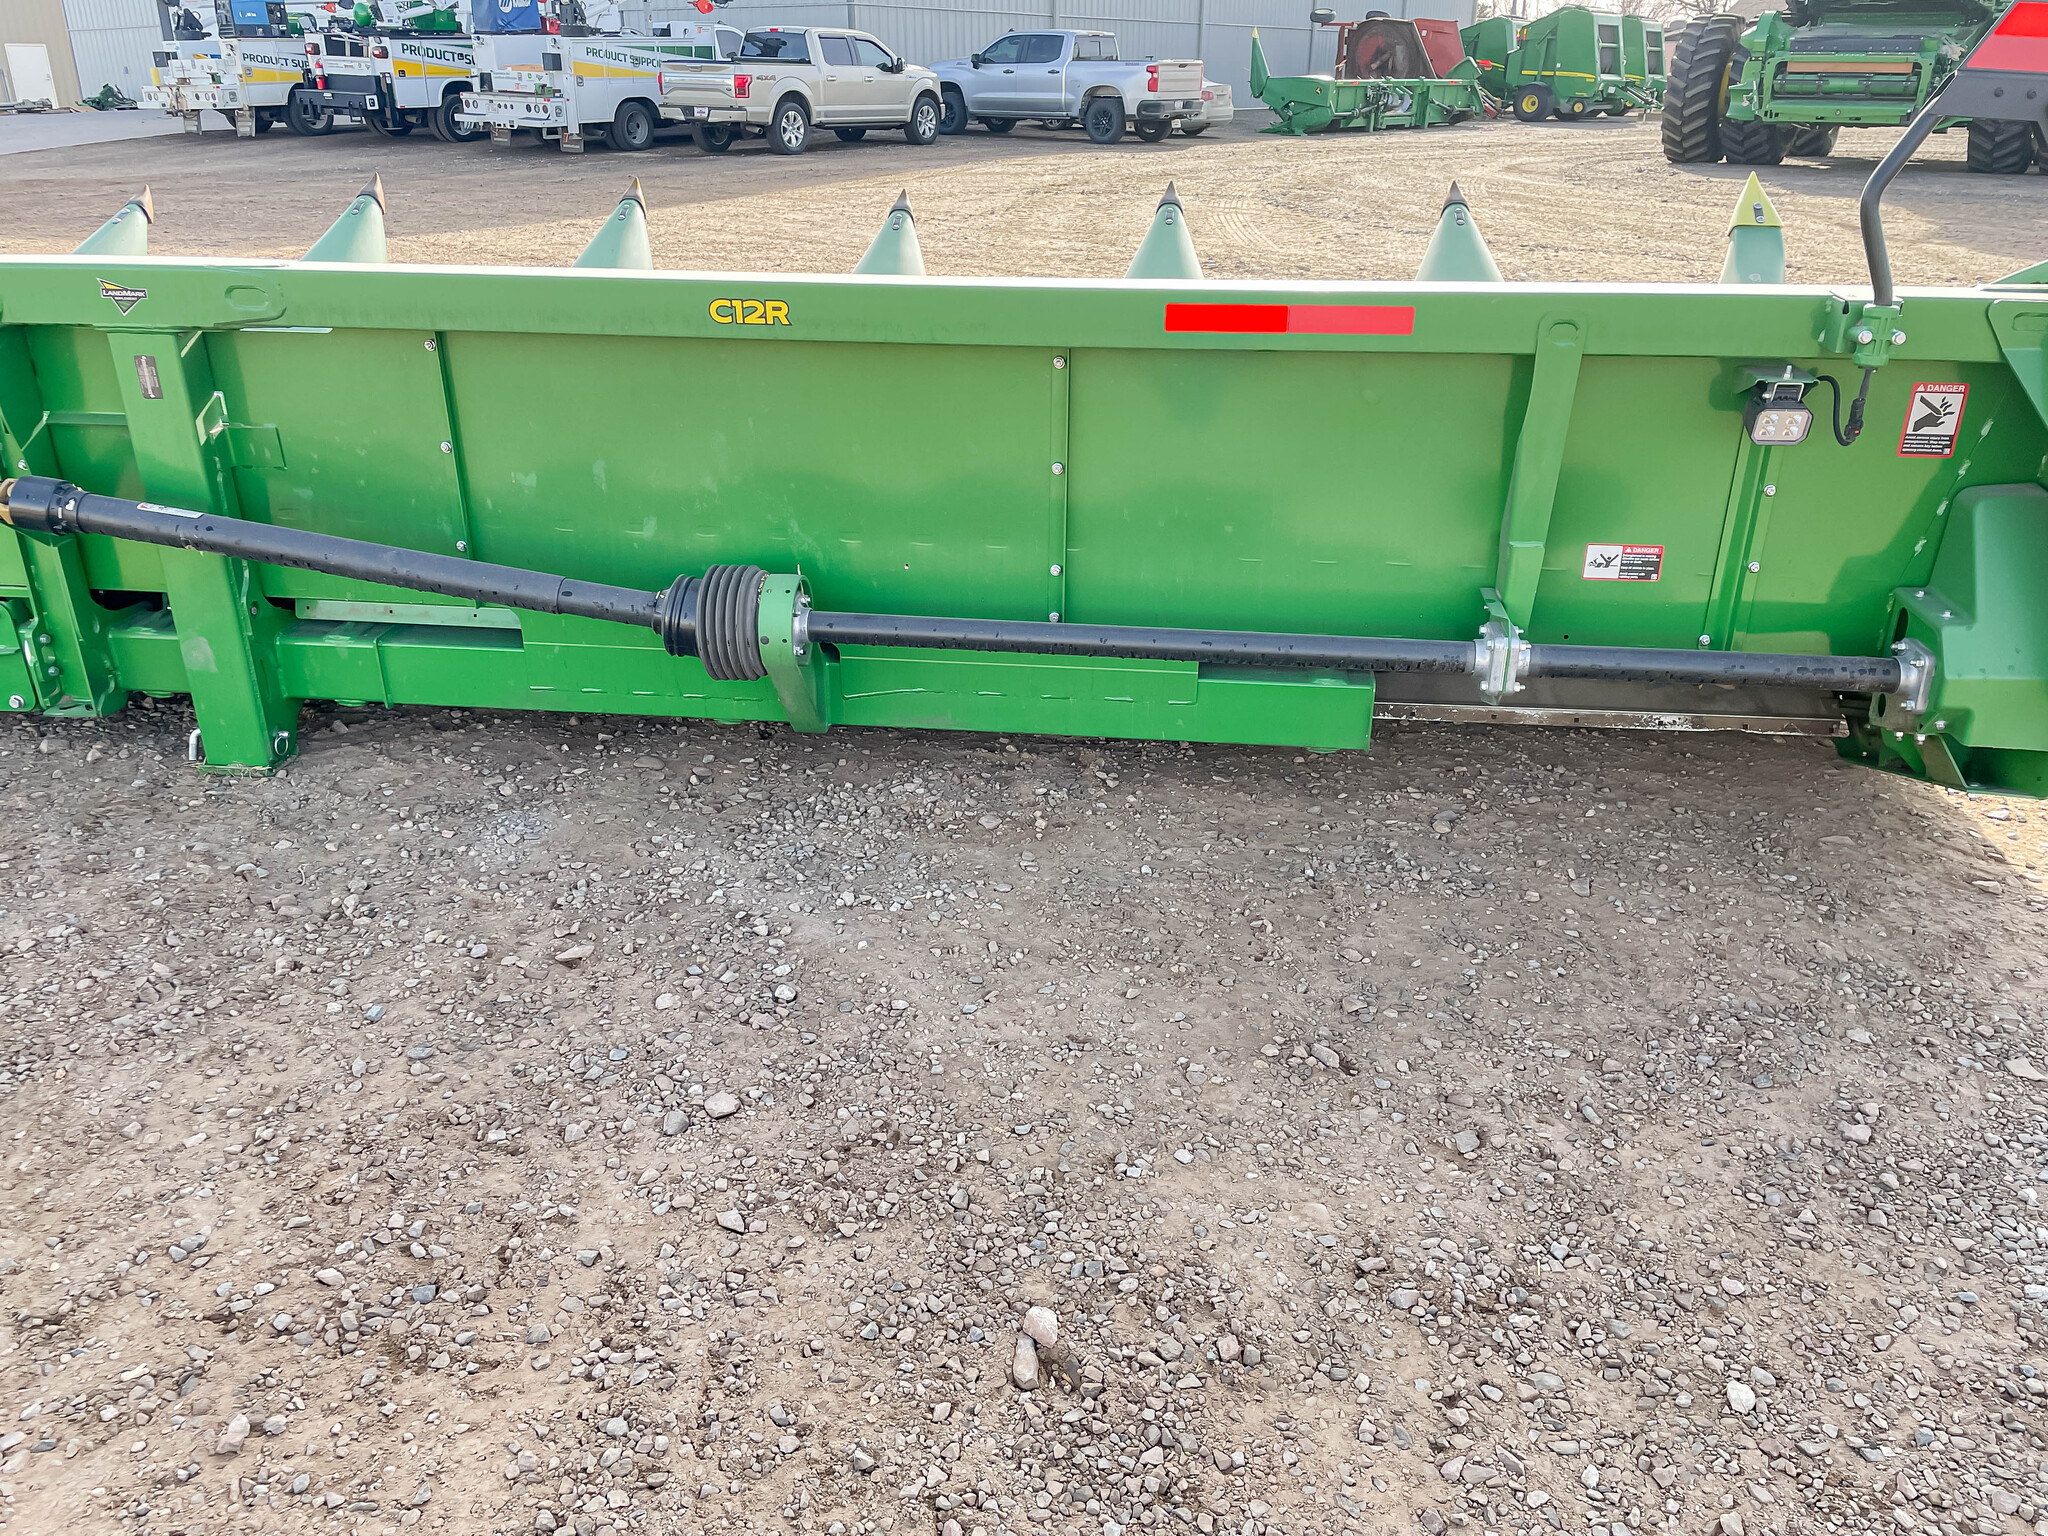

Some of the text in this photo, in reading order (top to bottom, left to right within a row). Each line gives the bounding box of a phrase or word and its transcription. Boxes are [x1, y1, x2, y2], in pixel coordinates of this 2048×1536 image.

[242, 52, 289, 67] PRODUCT
[401, 42, 457, 62] PRODUCT
[585, 46, 627, 63] PRODUCT
[708, 297, 793, 327] C12R
[1926, 384, 1966, 393] DANGER
